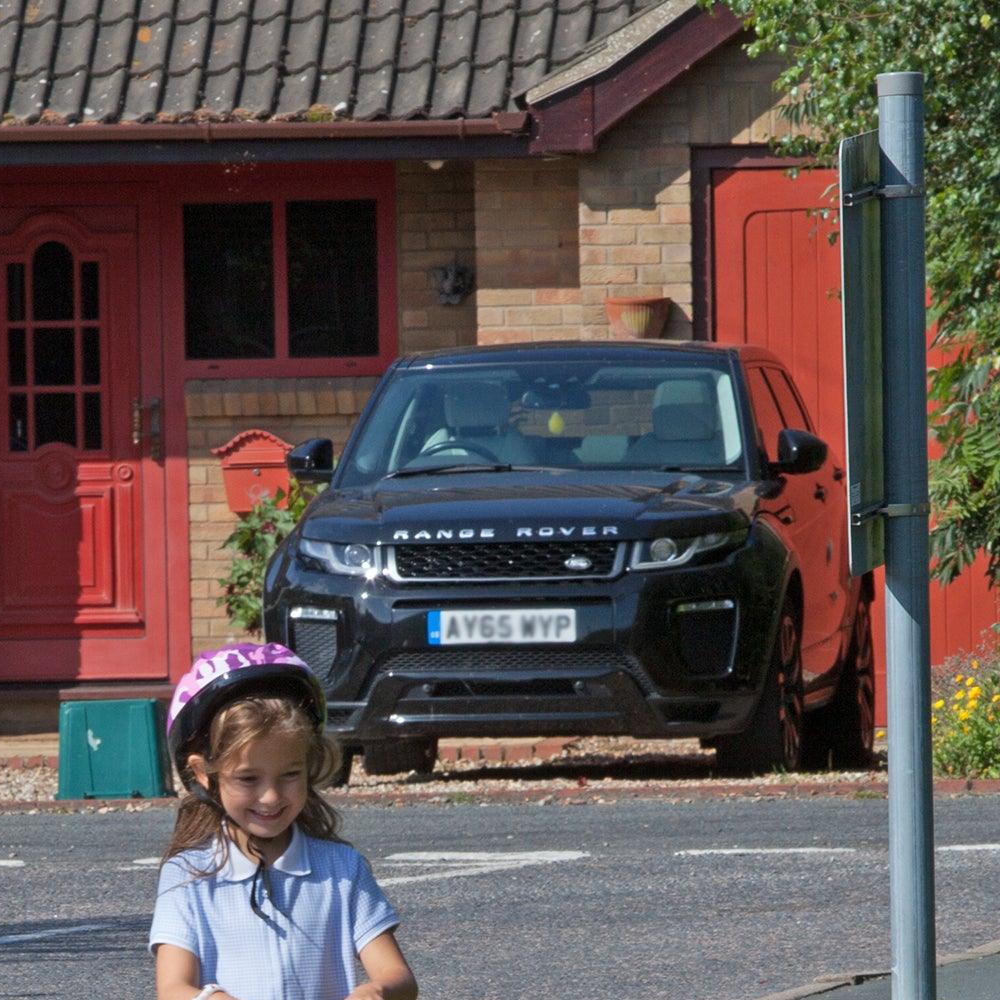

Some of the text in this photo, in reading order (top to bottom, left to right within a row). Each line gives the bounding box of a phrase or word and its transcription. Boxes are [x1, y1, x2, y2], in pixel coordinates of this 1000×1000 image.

[393, 526, 618, 540] RANGE ROVER
[446, 615, 513, 639] AY65
